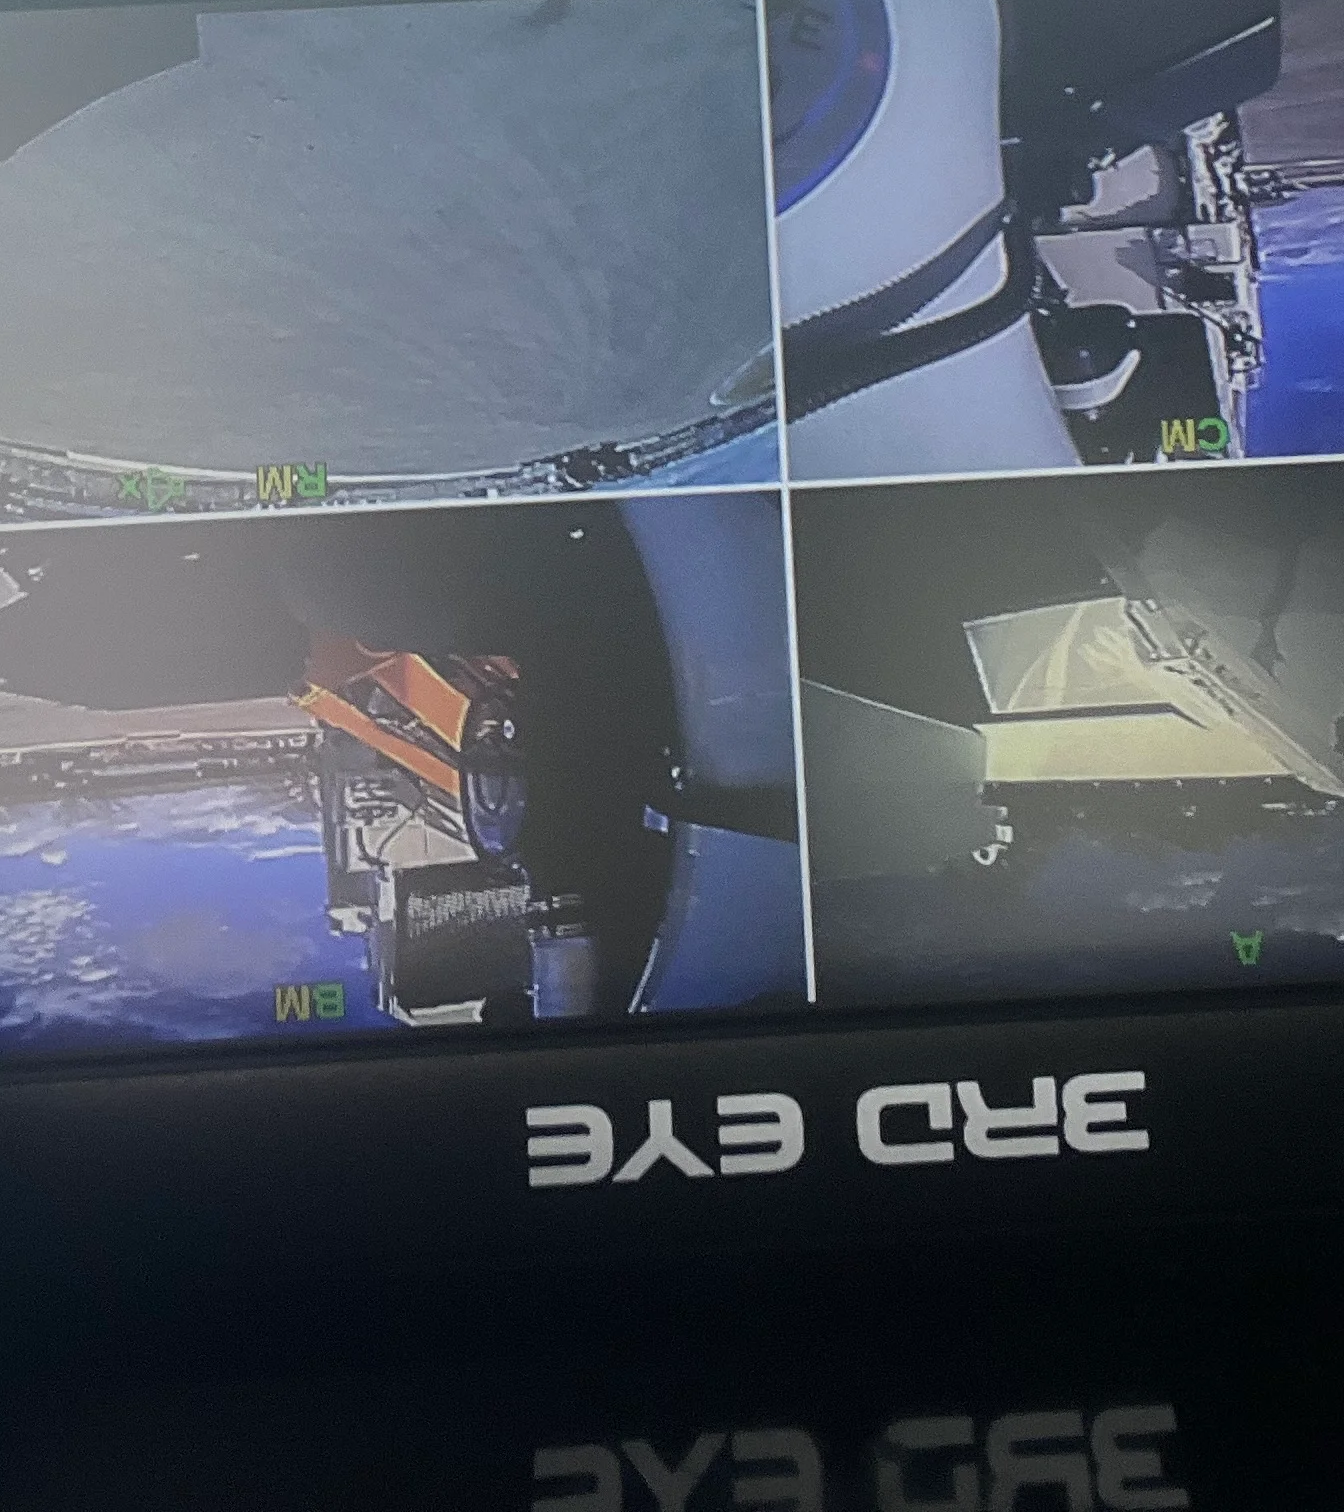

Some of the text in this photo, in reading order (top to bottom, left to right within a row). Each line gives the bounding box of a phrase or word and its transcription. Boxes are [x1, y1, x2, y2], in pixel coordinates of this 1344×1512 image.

[1160, 415, 1230, 455] CM
[256, 462, 328, 501] RM
[1230, 930, 1265, 967] A
[273, 981, 346, 1022] BM
[527, 1071, 1151, 1188] 3RD EYE
